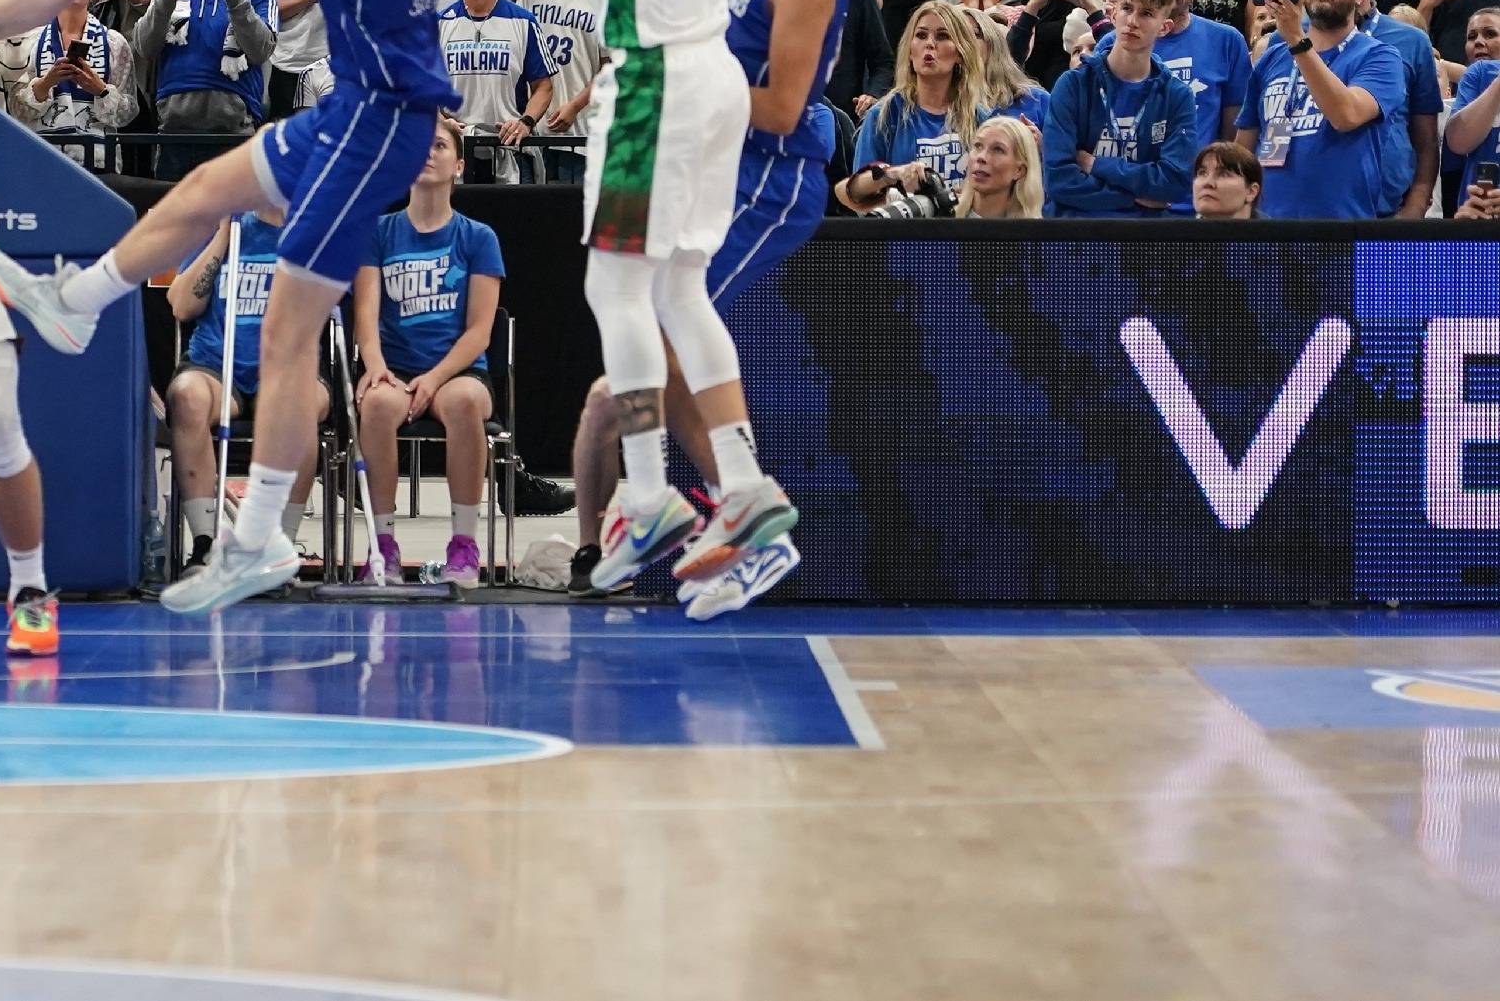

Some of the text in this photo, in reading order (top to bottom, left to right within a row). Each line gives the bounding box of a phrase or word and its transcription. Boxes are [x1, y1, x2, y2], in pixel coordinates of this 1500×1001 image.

[446, 41, 511, 52] BASKETBALL
[446, 50, 511, 71] FINLAND
[382, 258, 440, 277] WELCOME
[218, 272, 275, 299] WOL
[385, 266, 449, 303] WOLF
[399, 292, 460, 318] COUNTRY
